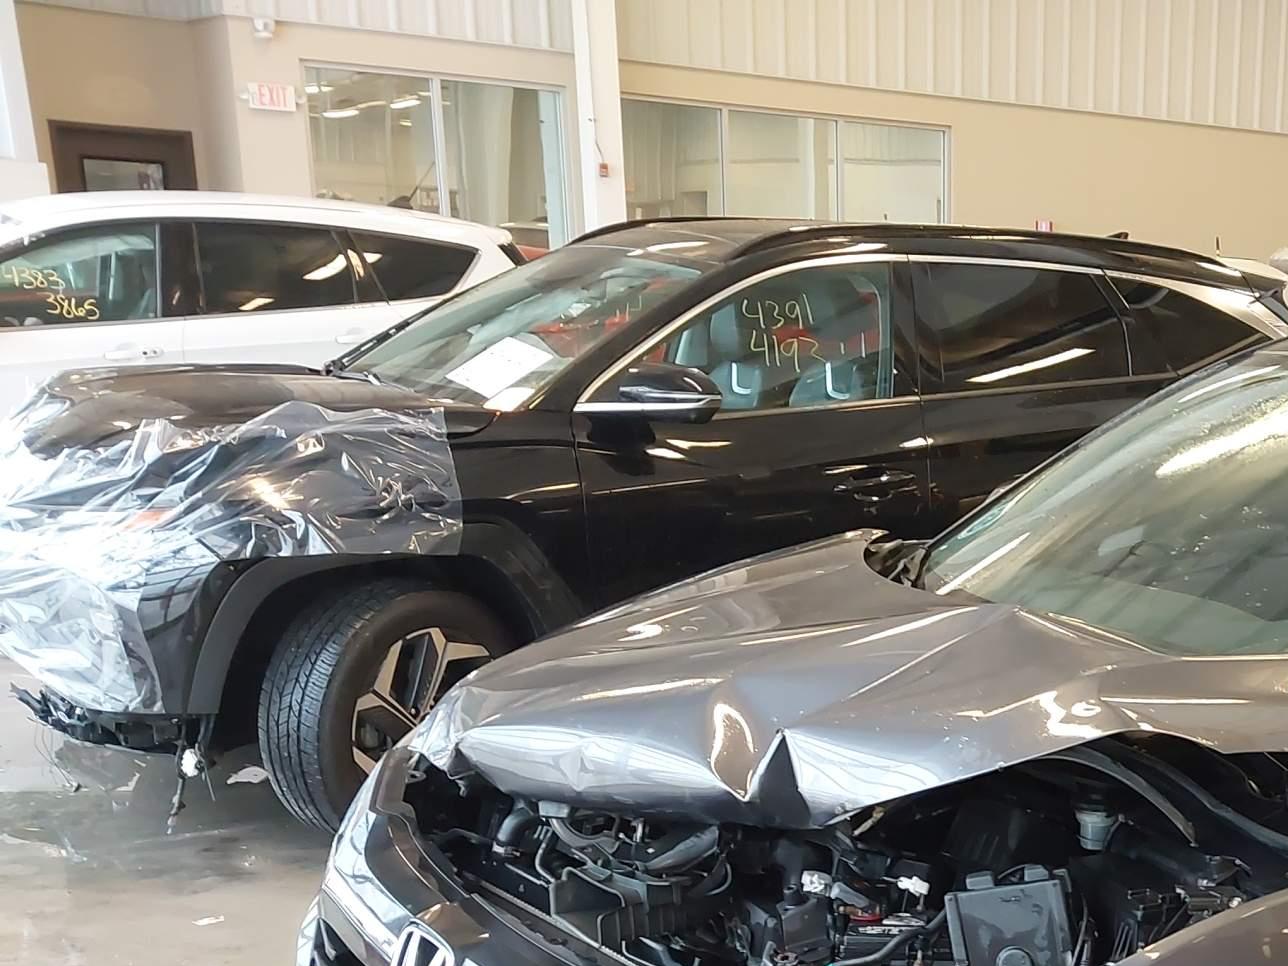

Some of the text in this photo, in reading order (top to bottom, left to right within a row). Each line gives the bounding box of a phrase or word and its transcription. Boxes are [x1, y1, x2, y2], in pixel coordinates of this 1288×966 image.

[256, 82, 289, 107] EXIT
[2, 264, 66, 289] 4383
[36, 291, 100, 319] 3865
[742, 294, 814, 329] 4391
